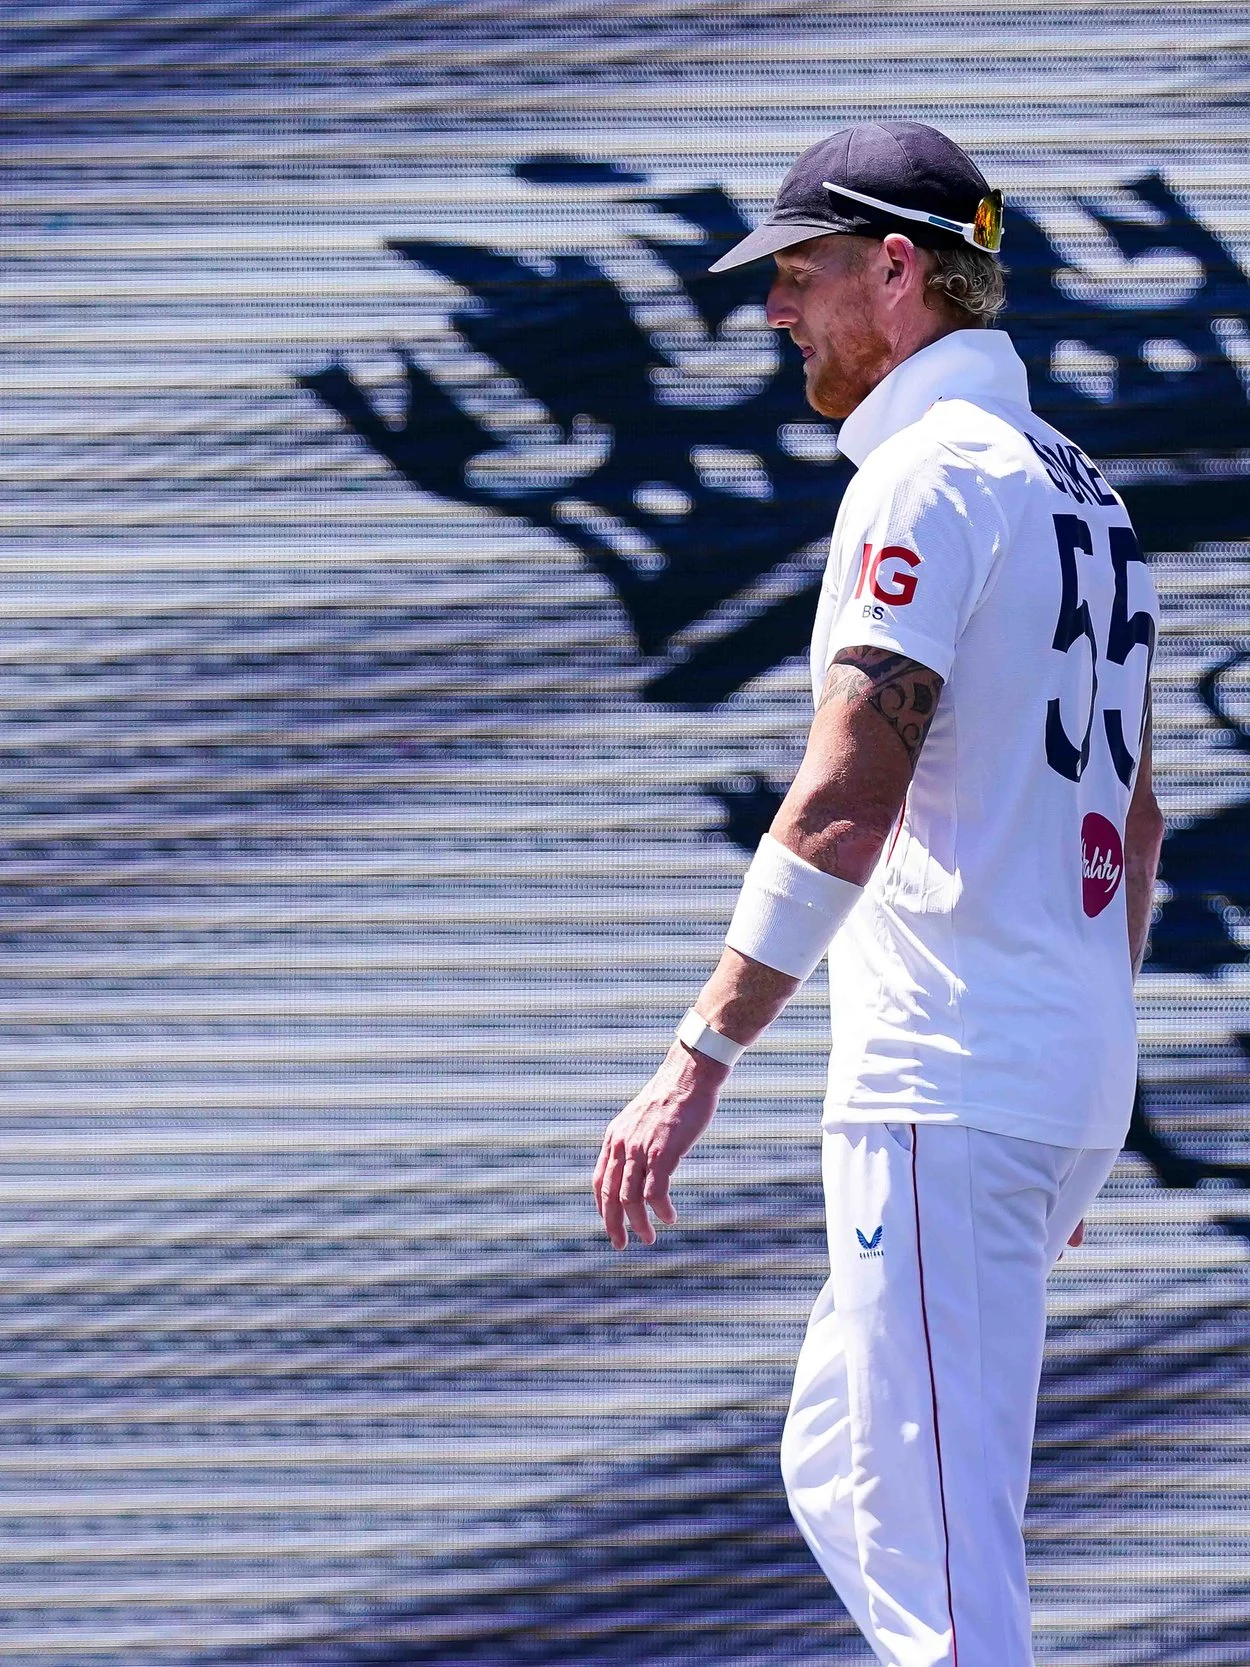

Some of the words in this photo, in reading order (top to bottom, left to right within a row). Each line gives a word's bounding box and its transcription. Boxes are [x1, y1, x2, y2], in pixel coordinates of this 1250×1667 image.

[854, 543, 922, 607] IG
[862, 604, 885, 621] BS
[1045, 513, 1156, 792] 55
